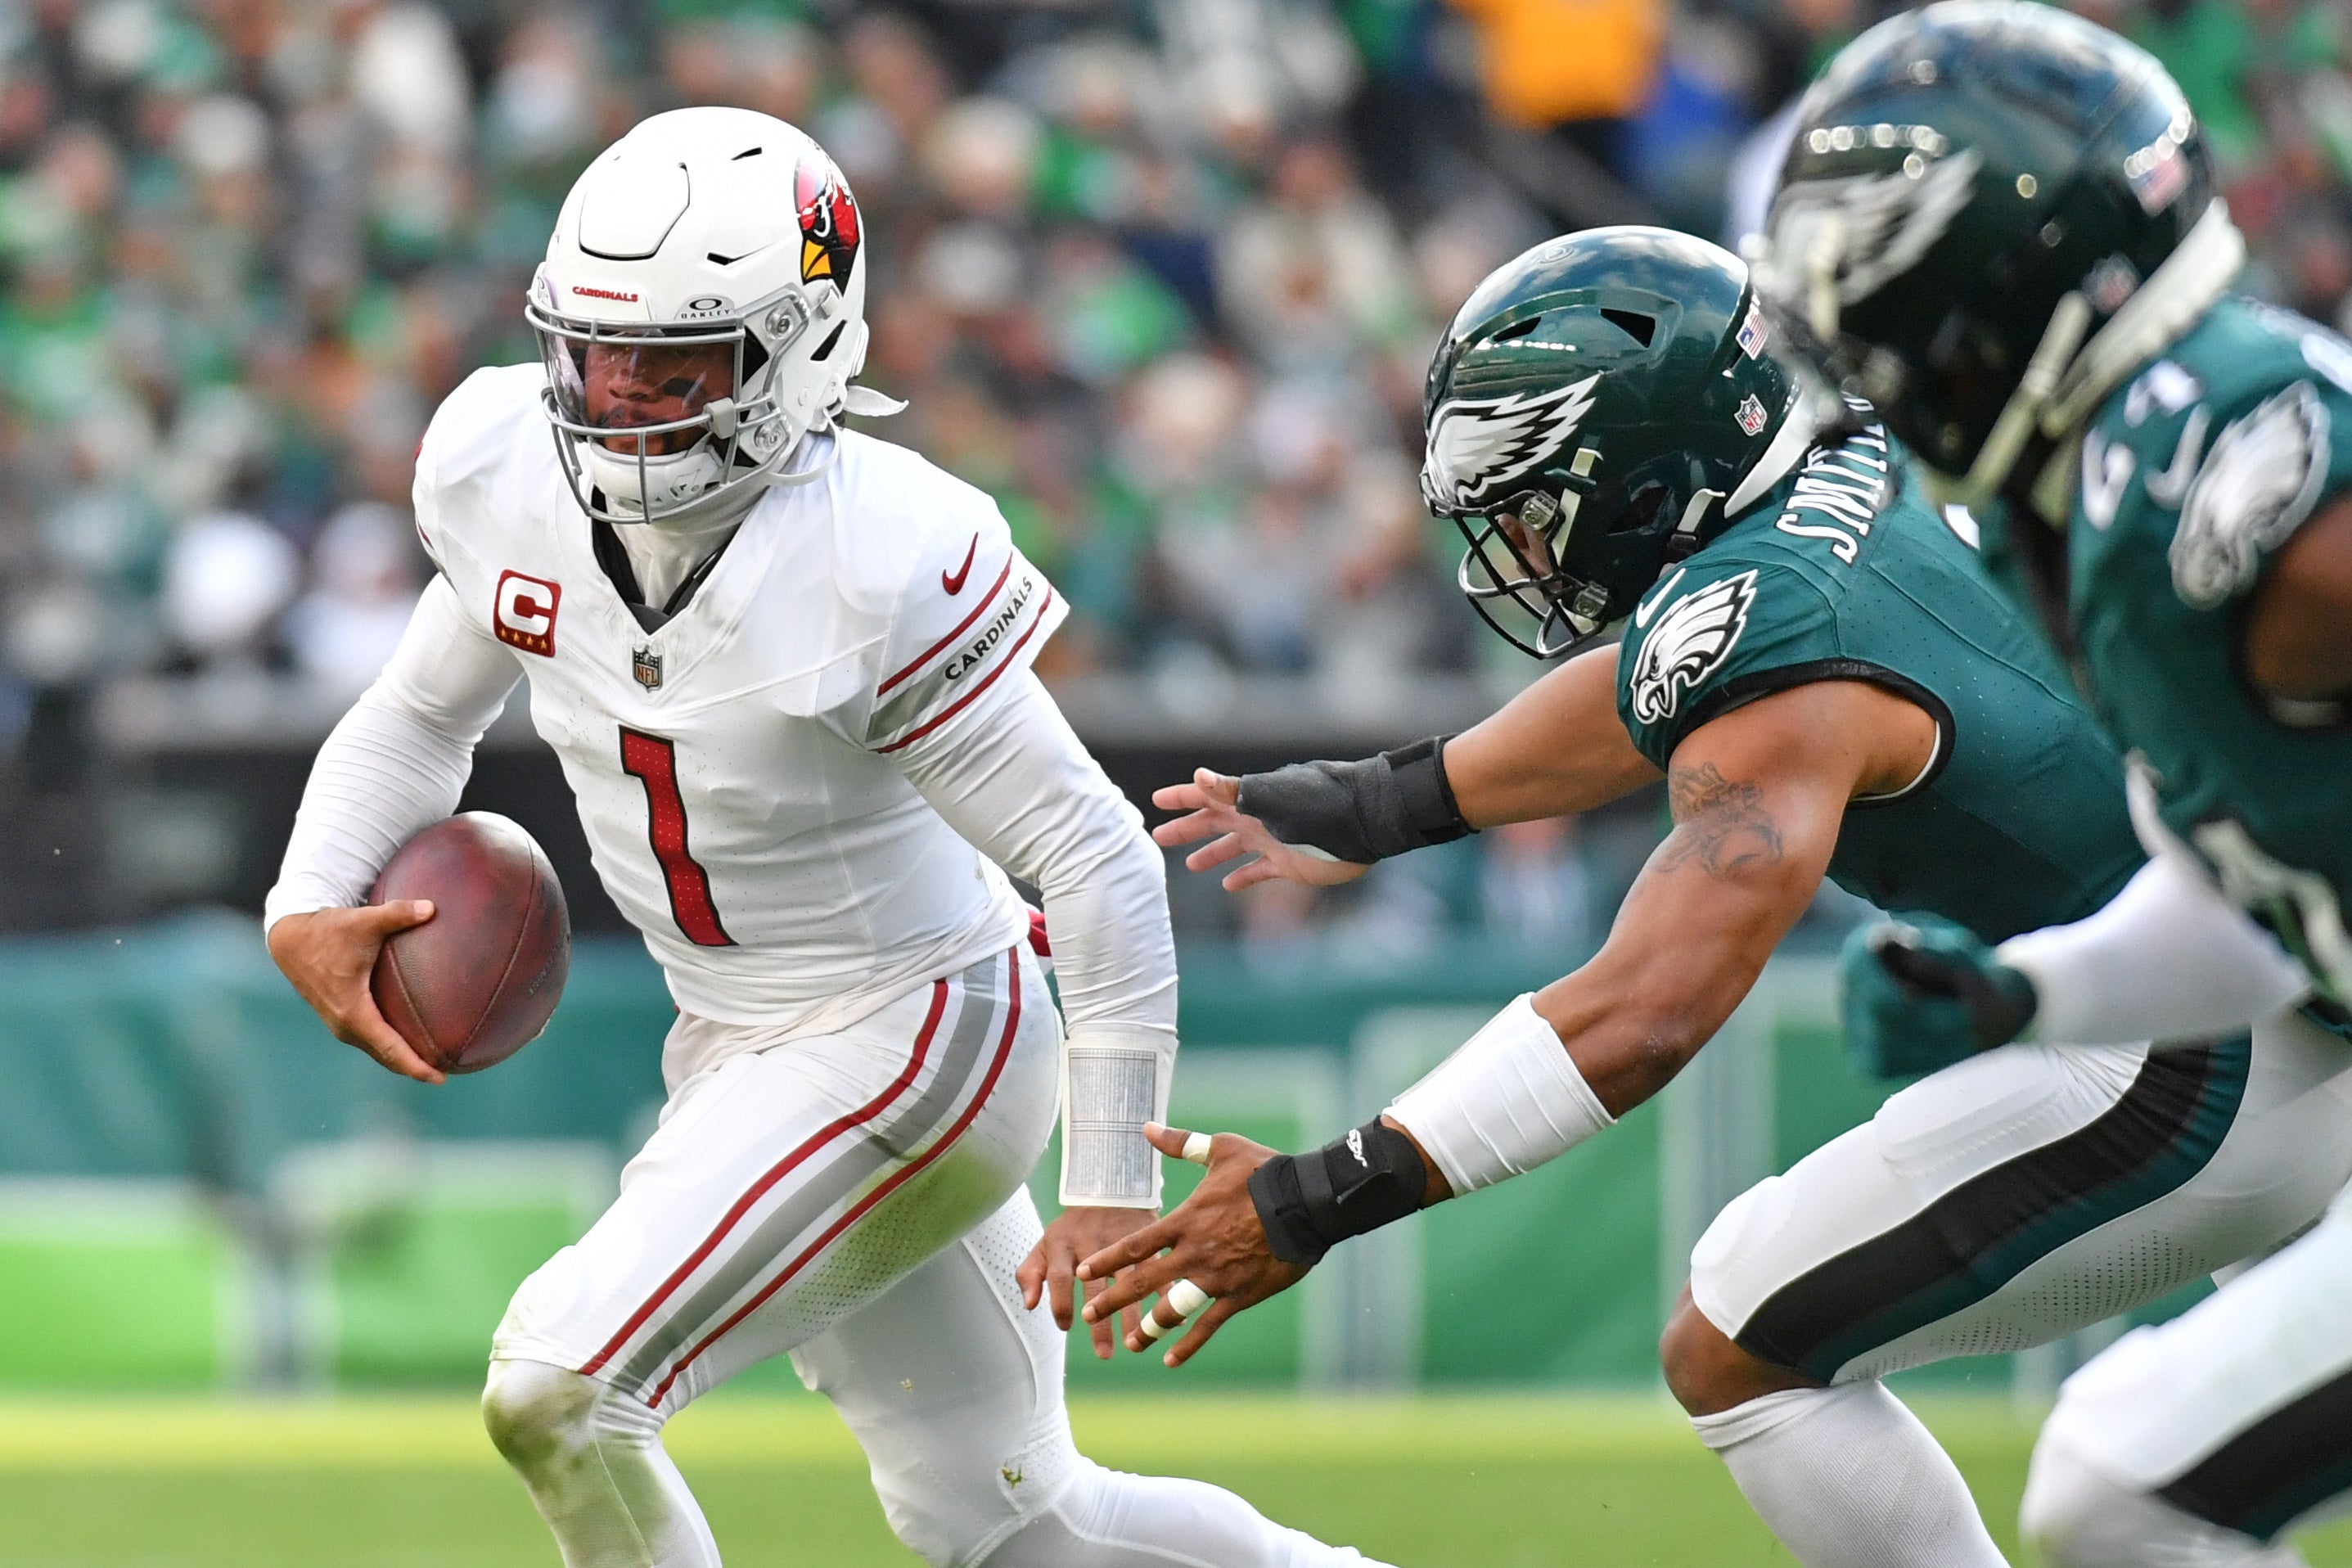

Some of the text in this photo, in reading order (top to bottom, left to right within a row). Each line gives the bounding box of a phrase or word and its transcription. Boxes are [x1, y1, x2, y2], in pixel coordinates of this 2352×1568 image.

[572, 286, 638, 302] CARDINALS
[681, 309, 730, 319] OAKLEY
[1745, 408, 1764, 431] NFL
[498, 576, 553, 637] C
[944, 576, 1033, 681] CARDINALS
[637, 665, 658, 685] NFL
[618, 723, 741, 947] 1
